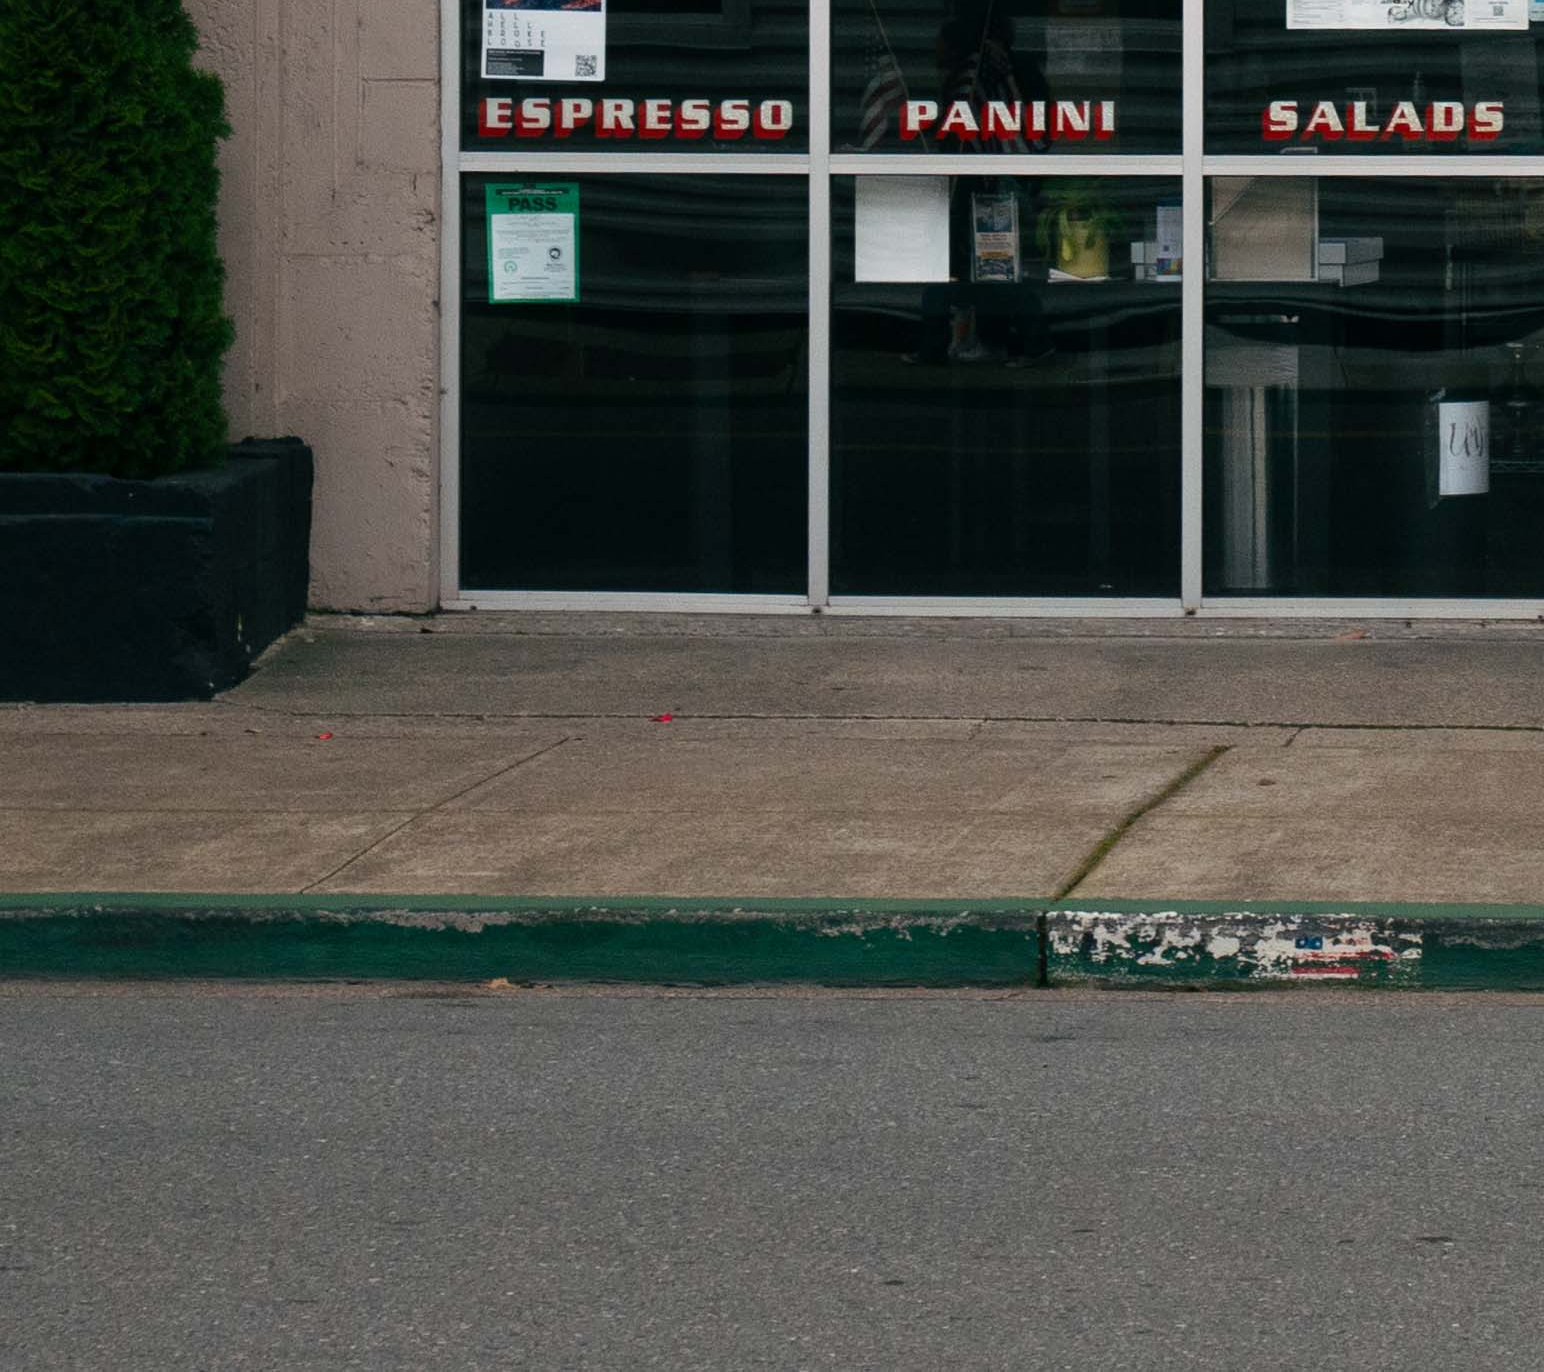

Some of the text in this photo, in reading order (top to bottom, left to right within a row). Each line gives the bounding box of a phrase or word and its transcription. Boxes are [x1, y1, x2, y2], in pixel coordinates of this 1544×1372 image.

[479, 97, 793, 138] ESPRESSO
[901, 100, 1115, 140] PANINI
[1263, 100, 1504, 141] SALADS
[508, 197, 558, 212] PASS
